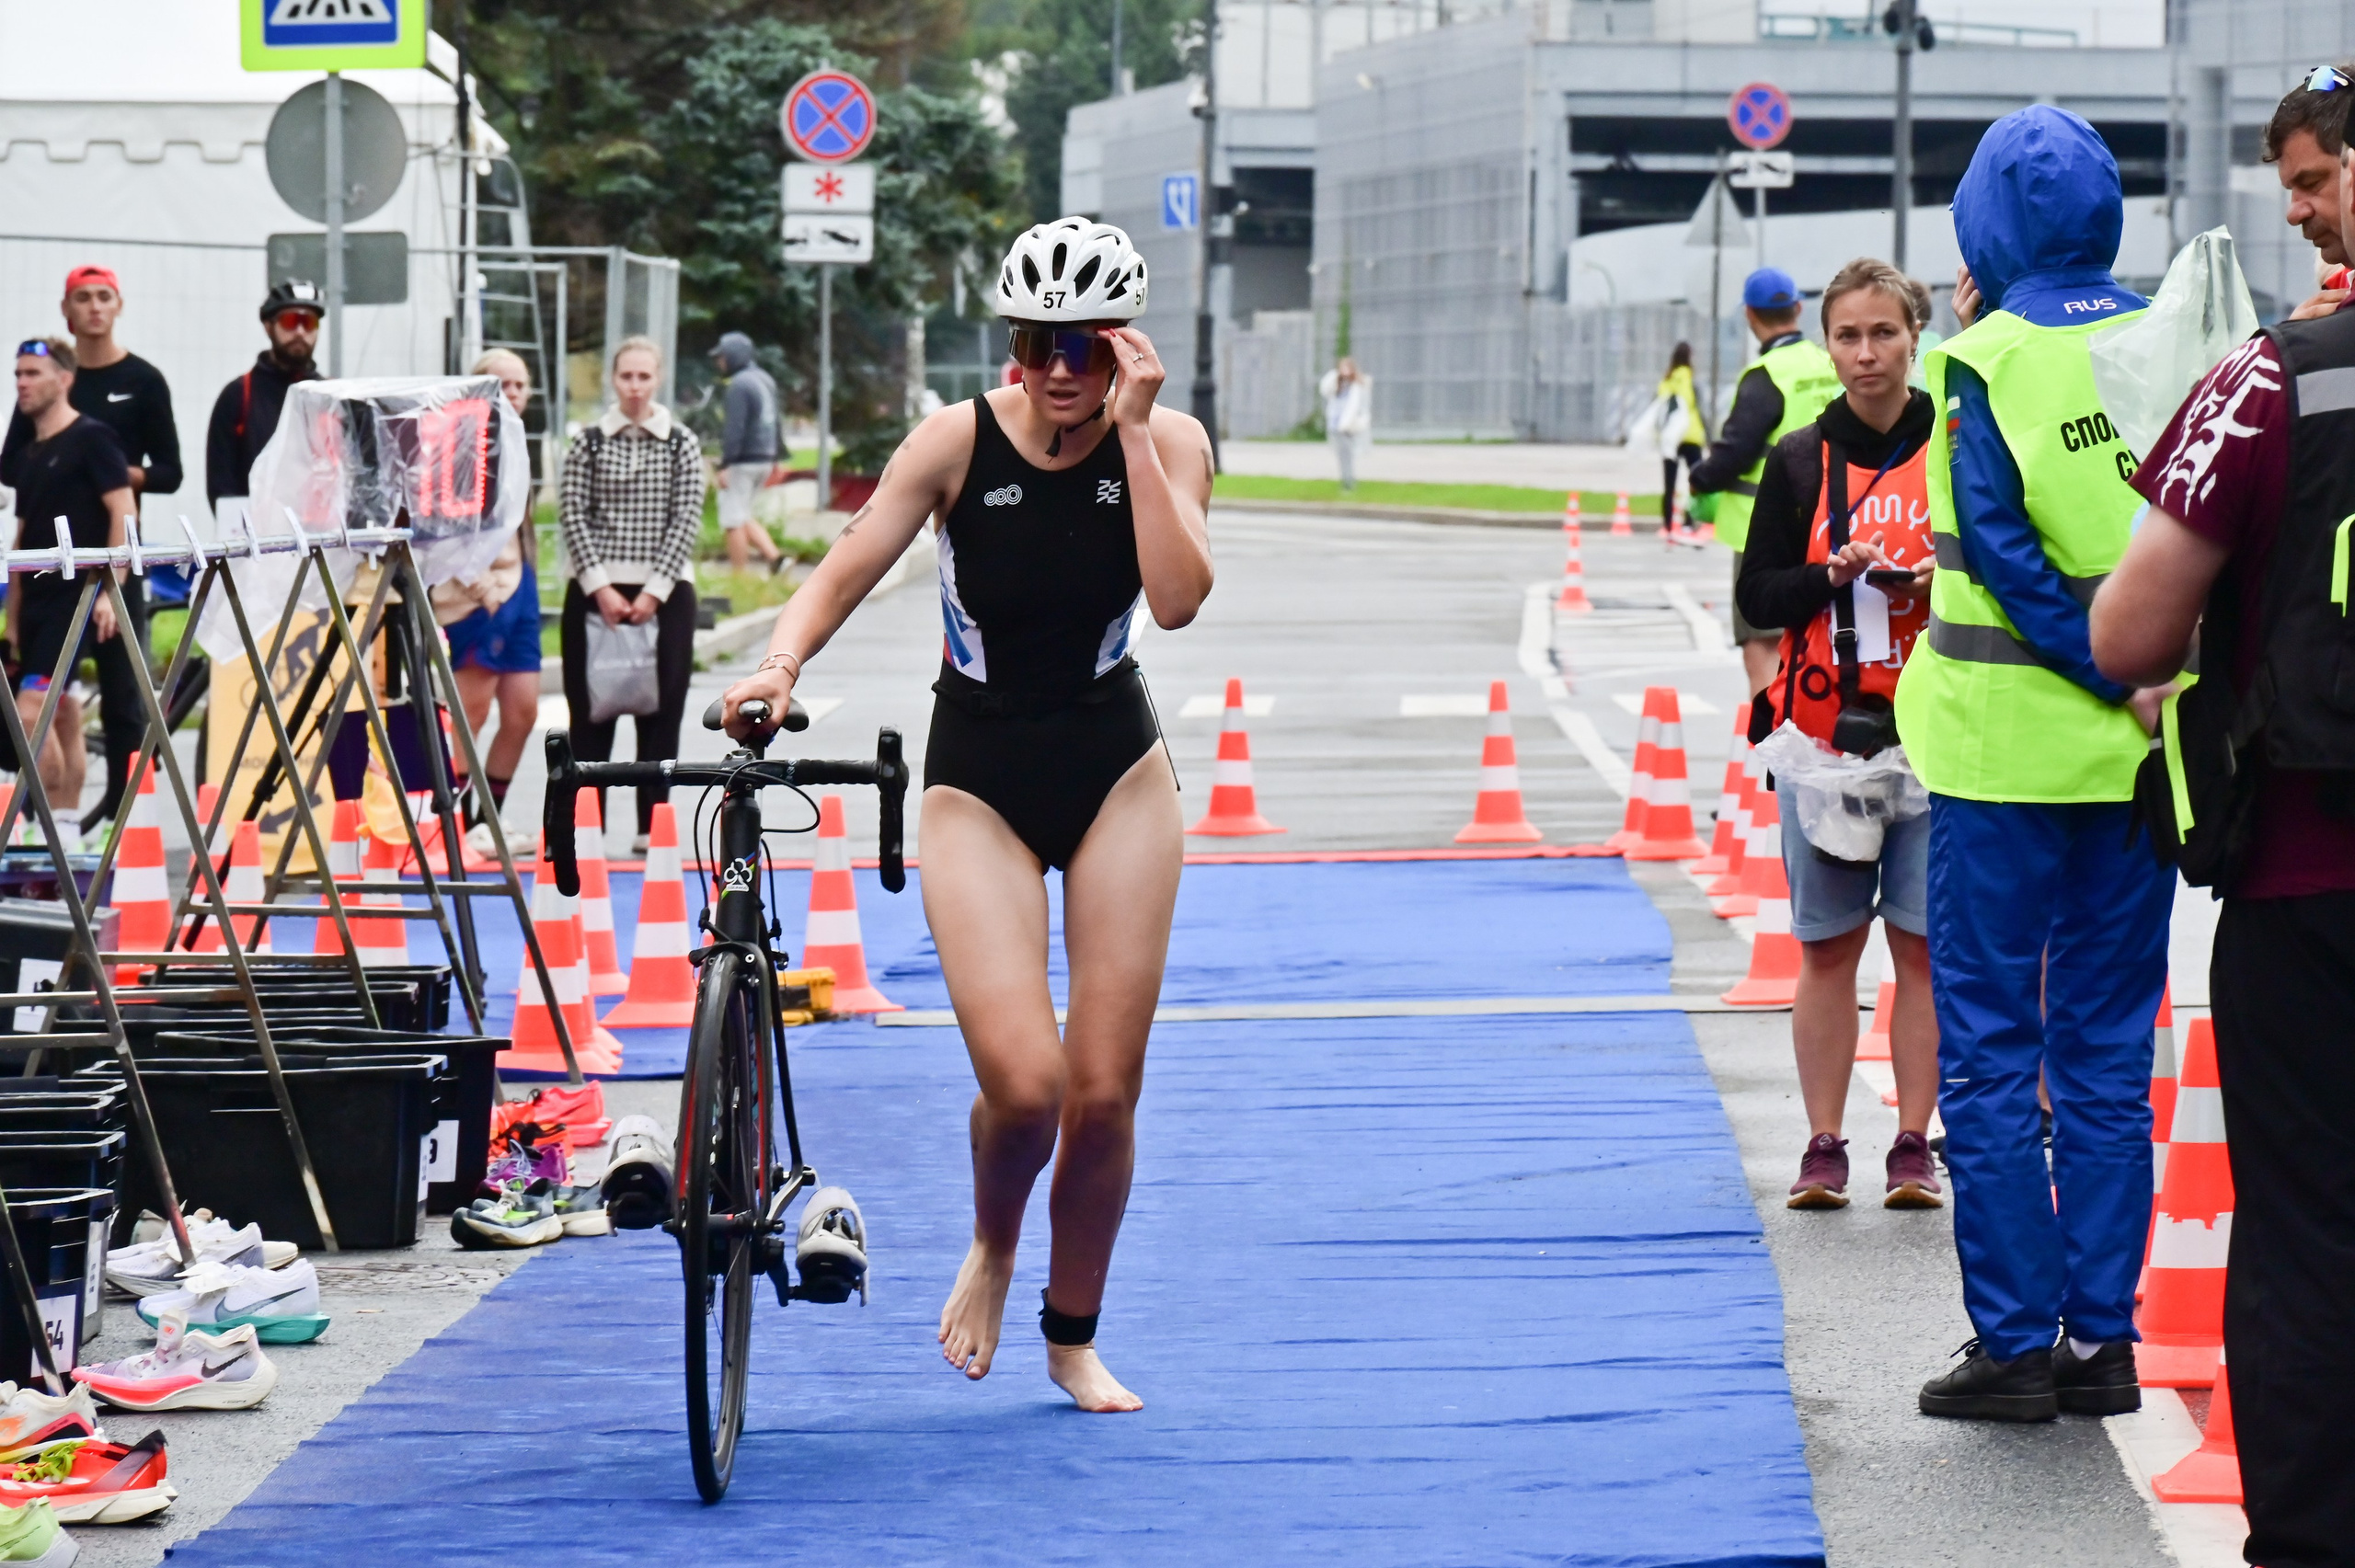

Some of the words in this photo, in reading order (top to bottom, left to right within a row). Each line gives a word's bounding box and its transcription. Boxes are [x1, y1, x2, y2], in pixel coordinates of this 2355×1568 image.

[1043, 292, 1066, 309] 57
[1135, 287, 1145, 306] 57
[2063, 298, 2118, 315] RUS
[2060, 411, 2120, 453] СПО
